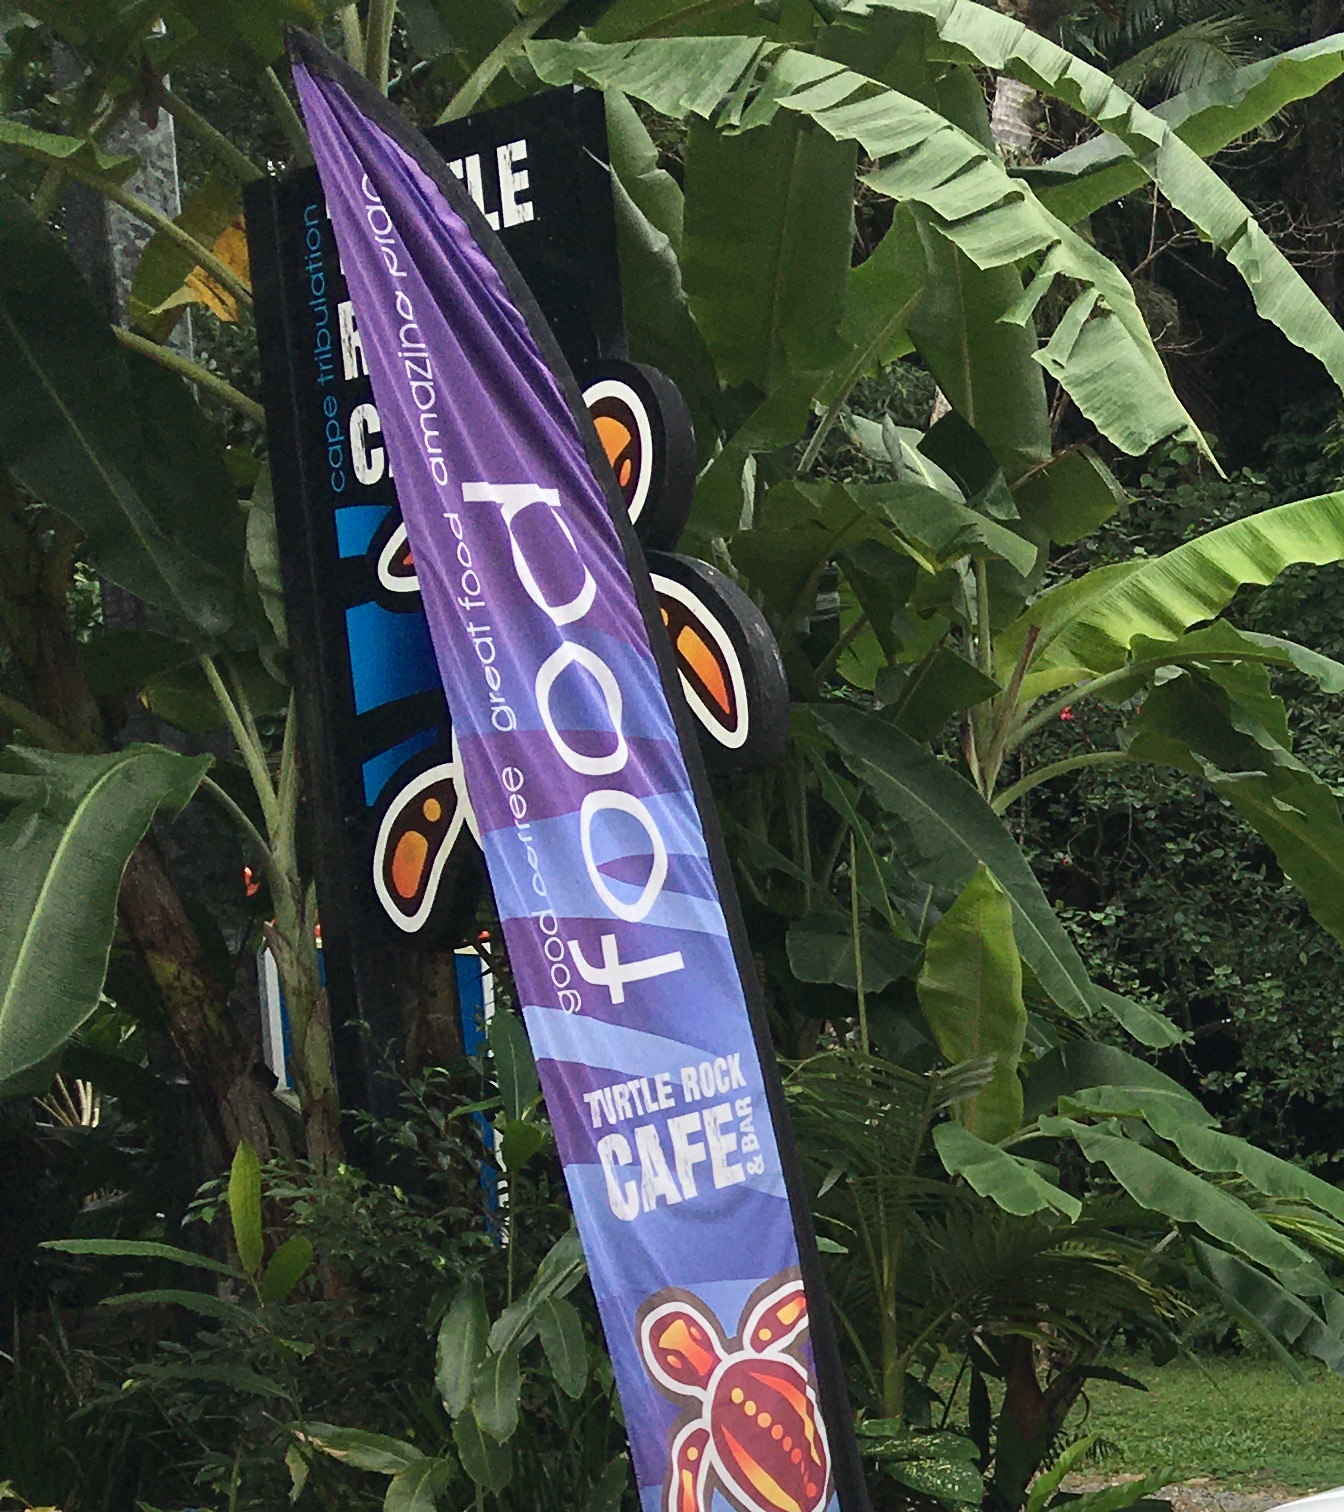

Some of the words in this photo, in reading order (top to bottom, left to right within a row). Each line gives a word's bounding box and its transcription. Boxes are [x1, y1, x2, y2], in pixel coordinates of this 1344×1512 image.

[304, 204, 334, 386] tribulation
[323, 395, 347, 493] cape
[442, 512, 486, 612] food
[464, 622, 518, 732] great
[462, 481, 686, 1004] food
[530, 909, 582, 1015] good
[583, 1072, 676, 1128] TURTLE
[680, 1053, 747, 1102] ROCK
[735, 1096, 760, 1153] BAR
[597, 1102, 747, 1222] CAFE
[746, 1153, 765, 1175] &
